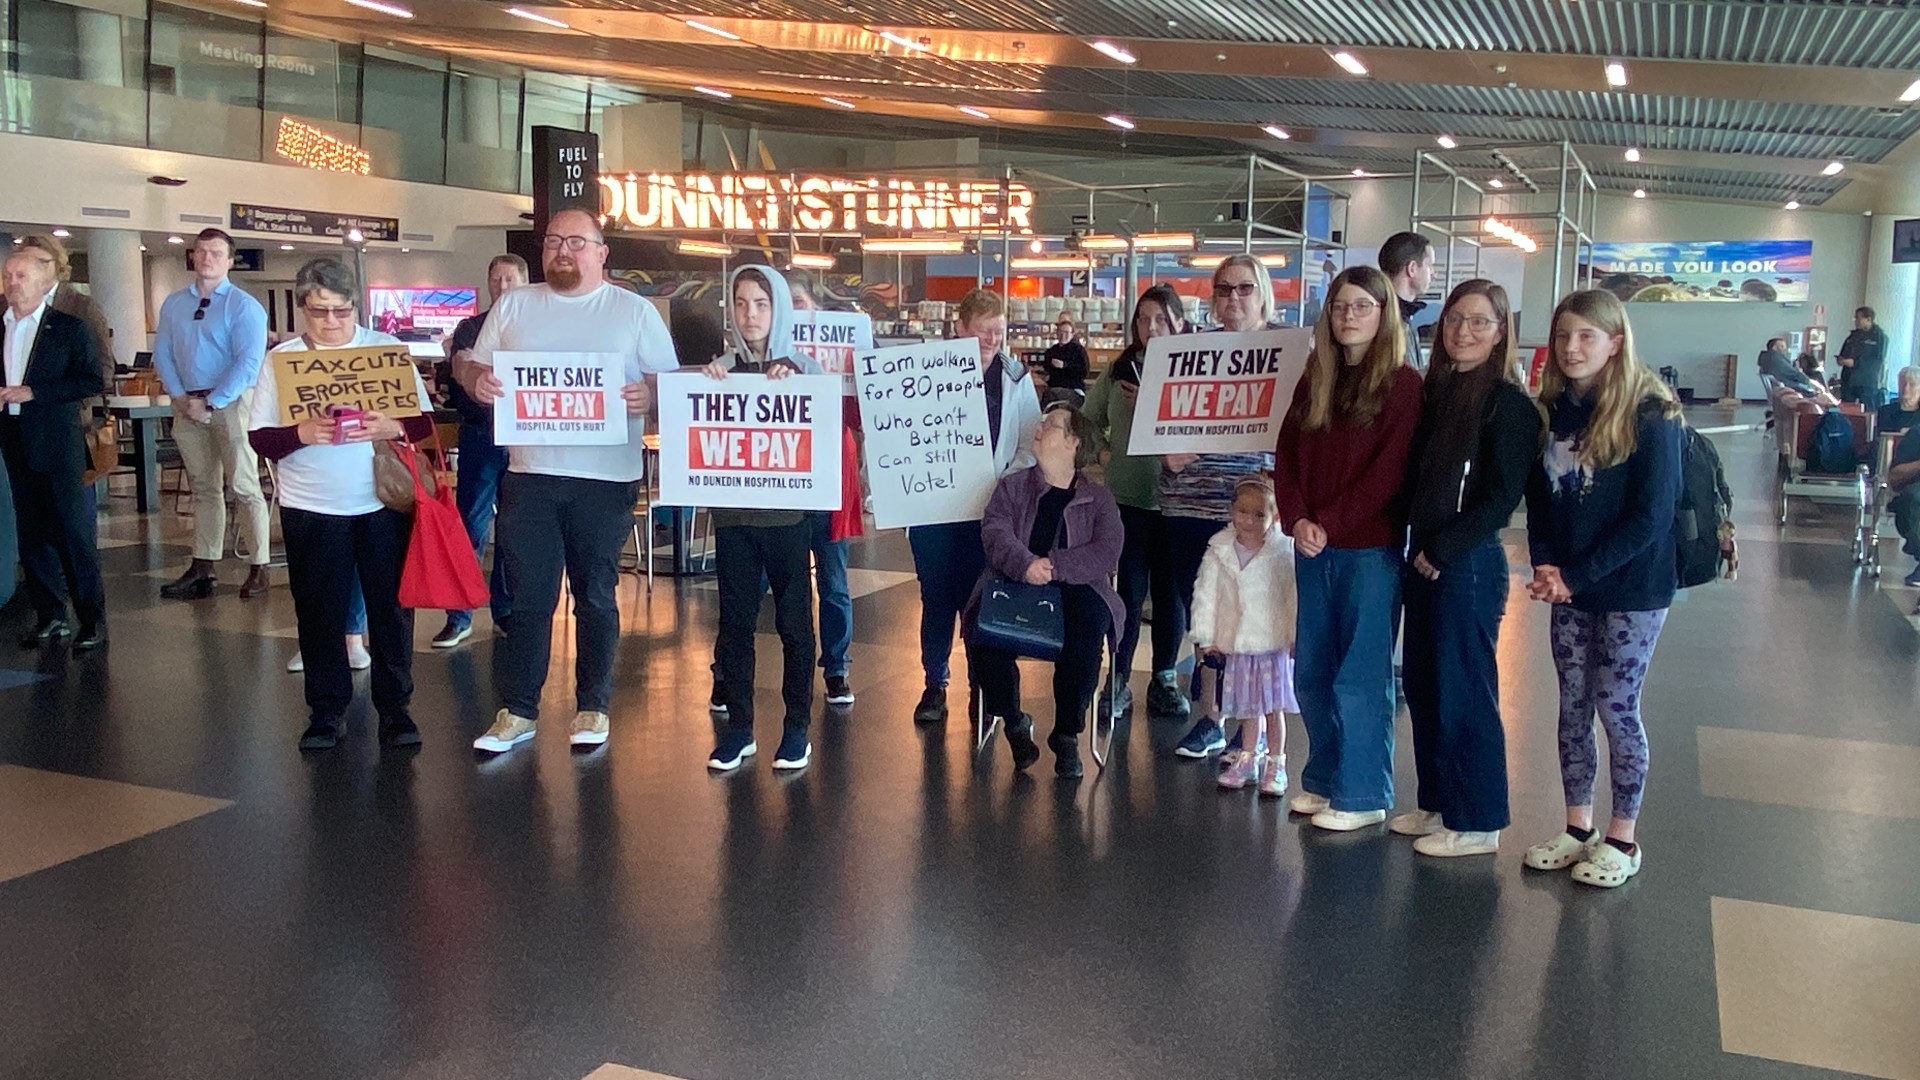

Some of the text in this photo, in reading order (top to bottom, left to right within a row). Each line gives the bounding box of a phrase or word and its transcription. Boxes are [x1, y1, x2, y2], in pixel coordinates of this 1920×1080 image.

[199, 41, 316, 76] Meeting Rooms
[559, 146, 588, 163] FUEL
[566, 164, 582, 180] TO
[564, 182, 584, 198] FLY
[1608, 260, 1779, 274] MADE YOU LOOK
[792, 323, 856, 344] HEY SAVE
[861, 355, 878, 377] I
[882, 356, 915, 374] am
[1168, 347, 1282, 377] THEY SAVE
[514, 366, 604, 387] THEY SAVE
[295, 378, 402, 403] BROKEN
[864, 383, 894, 400] for
[901, 375, 932, 399] 80
[521, 391, 597, 418] WE PAY
[687, 393, 812, 424] THEY SAVE
[1169, 381, 1267, 418] WE PAY
[516, 421, 605, 432] HOSPITAL CUTS HURT
[1154, 423, 1269, 436] NO DUNEDIN HOSPITAL CUTS
[910, 429, 985, 447] But they
[699, 430, 802, 469] WE PAY
[688, 475, 813, 489] NO DUNEDIN HOSPITAL CUTS
[901, 467, 956, 496] Vote!
